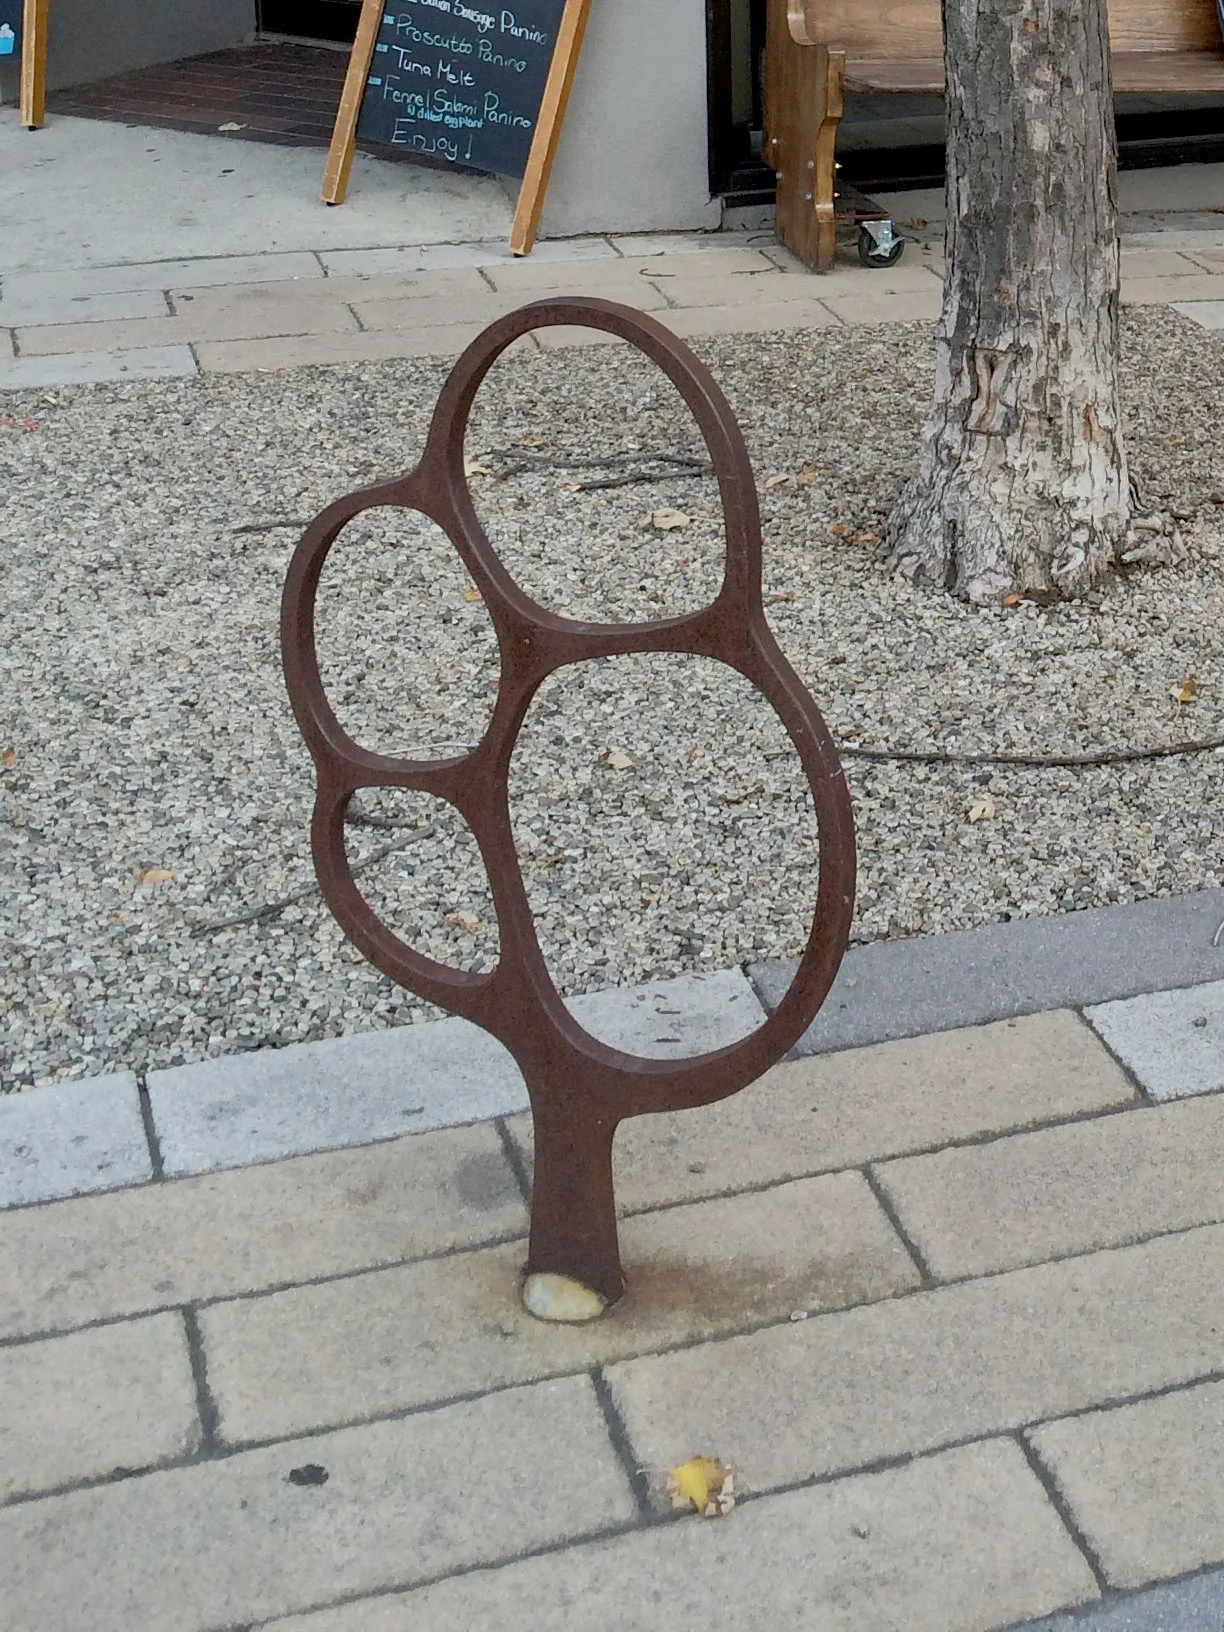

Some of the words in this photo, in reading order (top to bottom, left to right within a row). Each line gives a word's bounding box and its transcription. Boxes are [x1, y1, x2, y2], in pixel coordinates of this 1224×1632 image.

[500, 11, 548, 45] Panino
[392, 45, 431, 77] Tuna
[437, 59, 476, 86] Melt
[478, 39, 527, 72] Panino
[383, 74, 430, 108] Fennel
[433, 88, 478, 116] Salami
[483, 90, 532, 128] Panino
